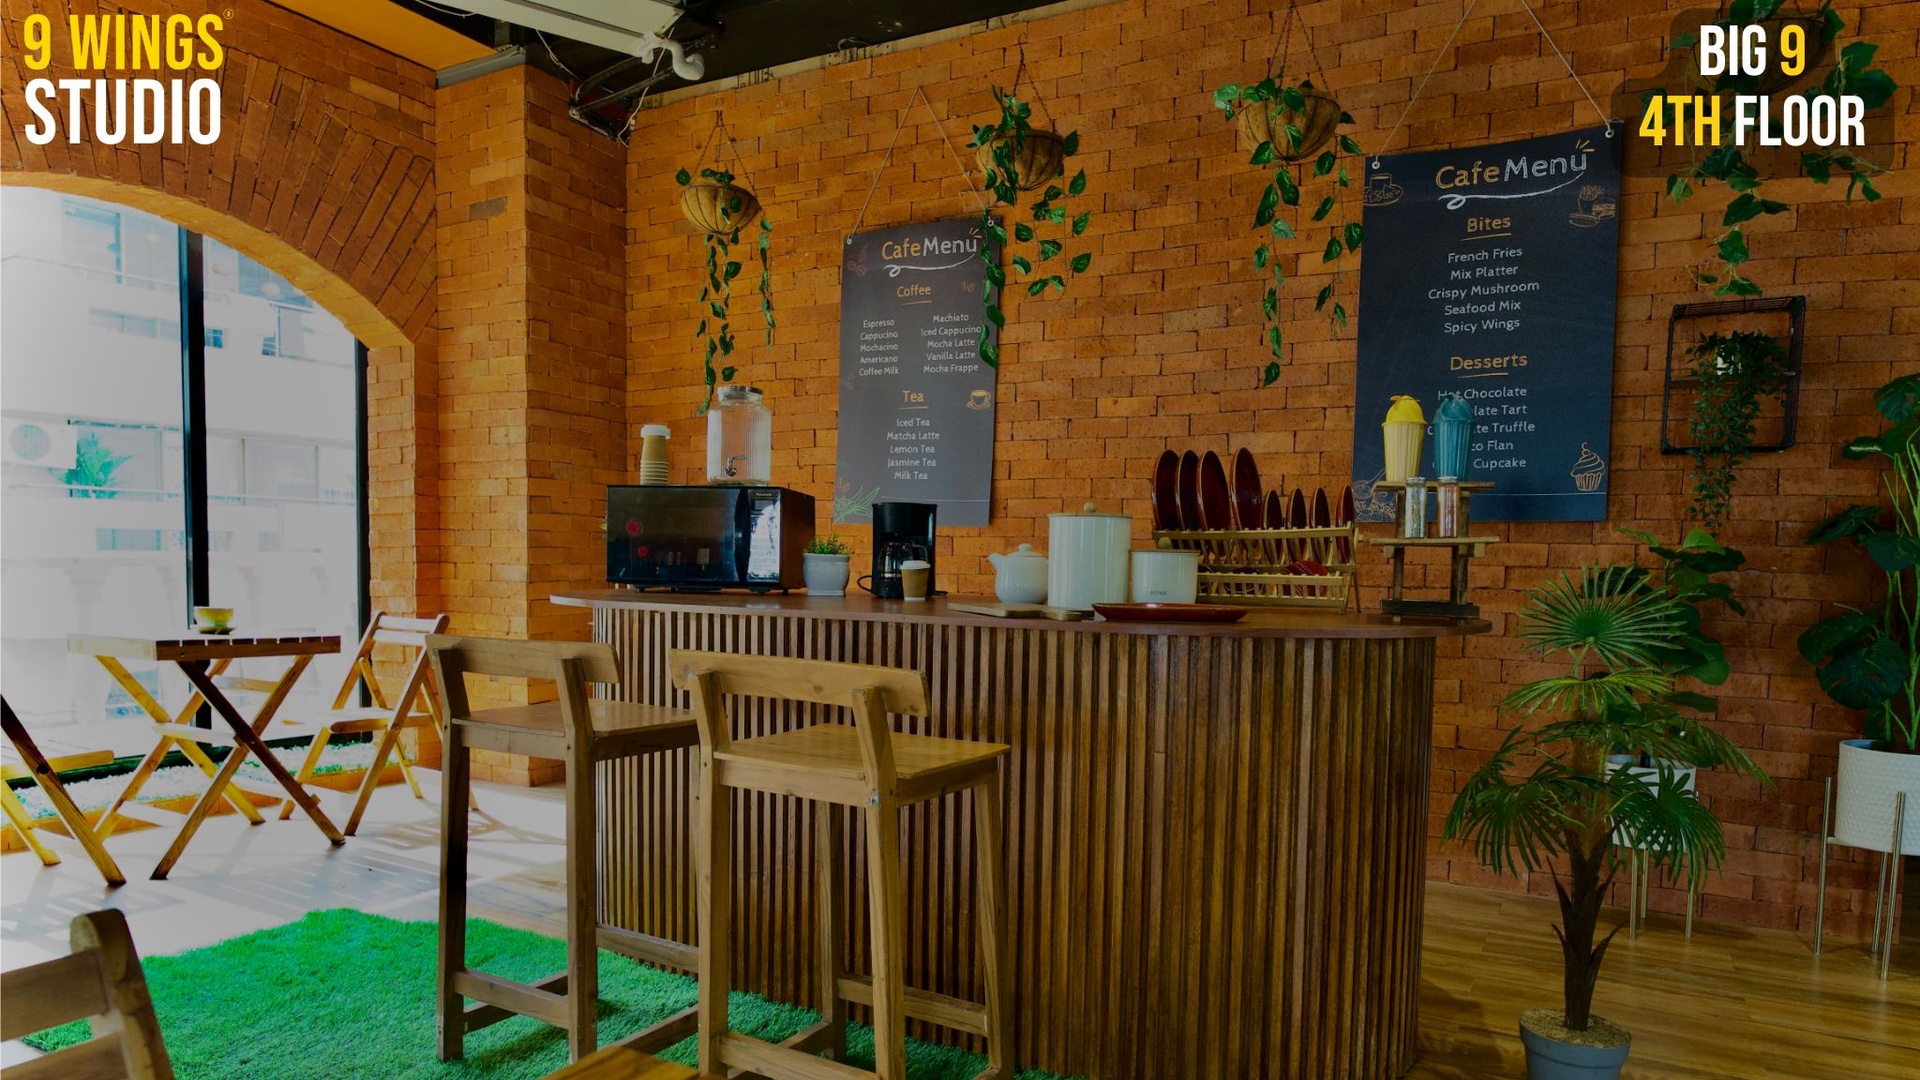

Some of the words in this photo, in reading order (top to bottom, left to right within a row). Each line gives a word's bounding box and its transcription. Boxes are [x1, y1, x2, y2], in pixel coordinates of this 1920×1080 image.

[1436, 161, 1500, 189] Cafe
[1504, 153, 1587, 181] Menu
[1467, 217, 1511, 233] Bites
[882, 238, 920, 260] Cafe
[923, 236, 977, 256] Menu
[1447, 250, 1488, 263] French
[1493, 247, 1523, 259] Fries
[1451, 269, 1471, 279] Mix
[1476, 265, 1518, 277] Platter
[897, 285, 932, 297] Coffee
[1428, 287, 1467, 300] Crispy
[1471, 281, 1539, 296] Mushroom
[1444, 303, 1495, 315] Seafood
[1499, 300, 1521, 311] Mix
[863, 319, 895, 328] Espresso
[933, 314, 969, 323] Machiato
[921, 328, 937, 336] Iced
[939, 326, 981, 336] Cappucino
[1444, 321, 1477, 335] Spicy
[1482, 319, 1520, 331] Wings
[860, 332, 898, 341] Cappucino
[927, 339, 952, 348] Mocha
[860, 355, 898, 364] Americano
[927, 352, 953, 360] Vanilla
[955, 351, 975, 359] Latte
[1450, 353, 1528, 371] Desserts
[859, 368, 882, 376] Coffee
[884, 367, 899, 375] Milk
[924, 364, 949, 373] Mocha
[951, 364, 979, 373] Frappe
[902, 390, 924, 402] Tea
[1464, 387, 1527, 399] Chocolate
[1501, 405, 1527, 415] Tart
[896, 419, 913, 427] Iced
[916, 418, 930, 427] Tea
[1493, 421, 1535, 433] Truffle
[887, 432, 916, 440] Matcha
[919, 431, 940, 439] Latte
[921, 445, 935, 453] Tea
[1488, 441, 1513, 450] Flan
[888, 458, 920, 468] Jasmine
[922, 458, 936, 466] Tea
[1474, 458, 1526, 471] Cupcake
[894, 471, 911, 480] Milk
[914, 471, 928, 480] Tea
